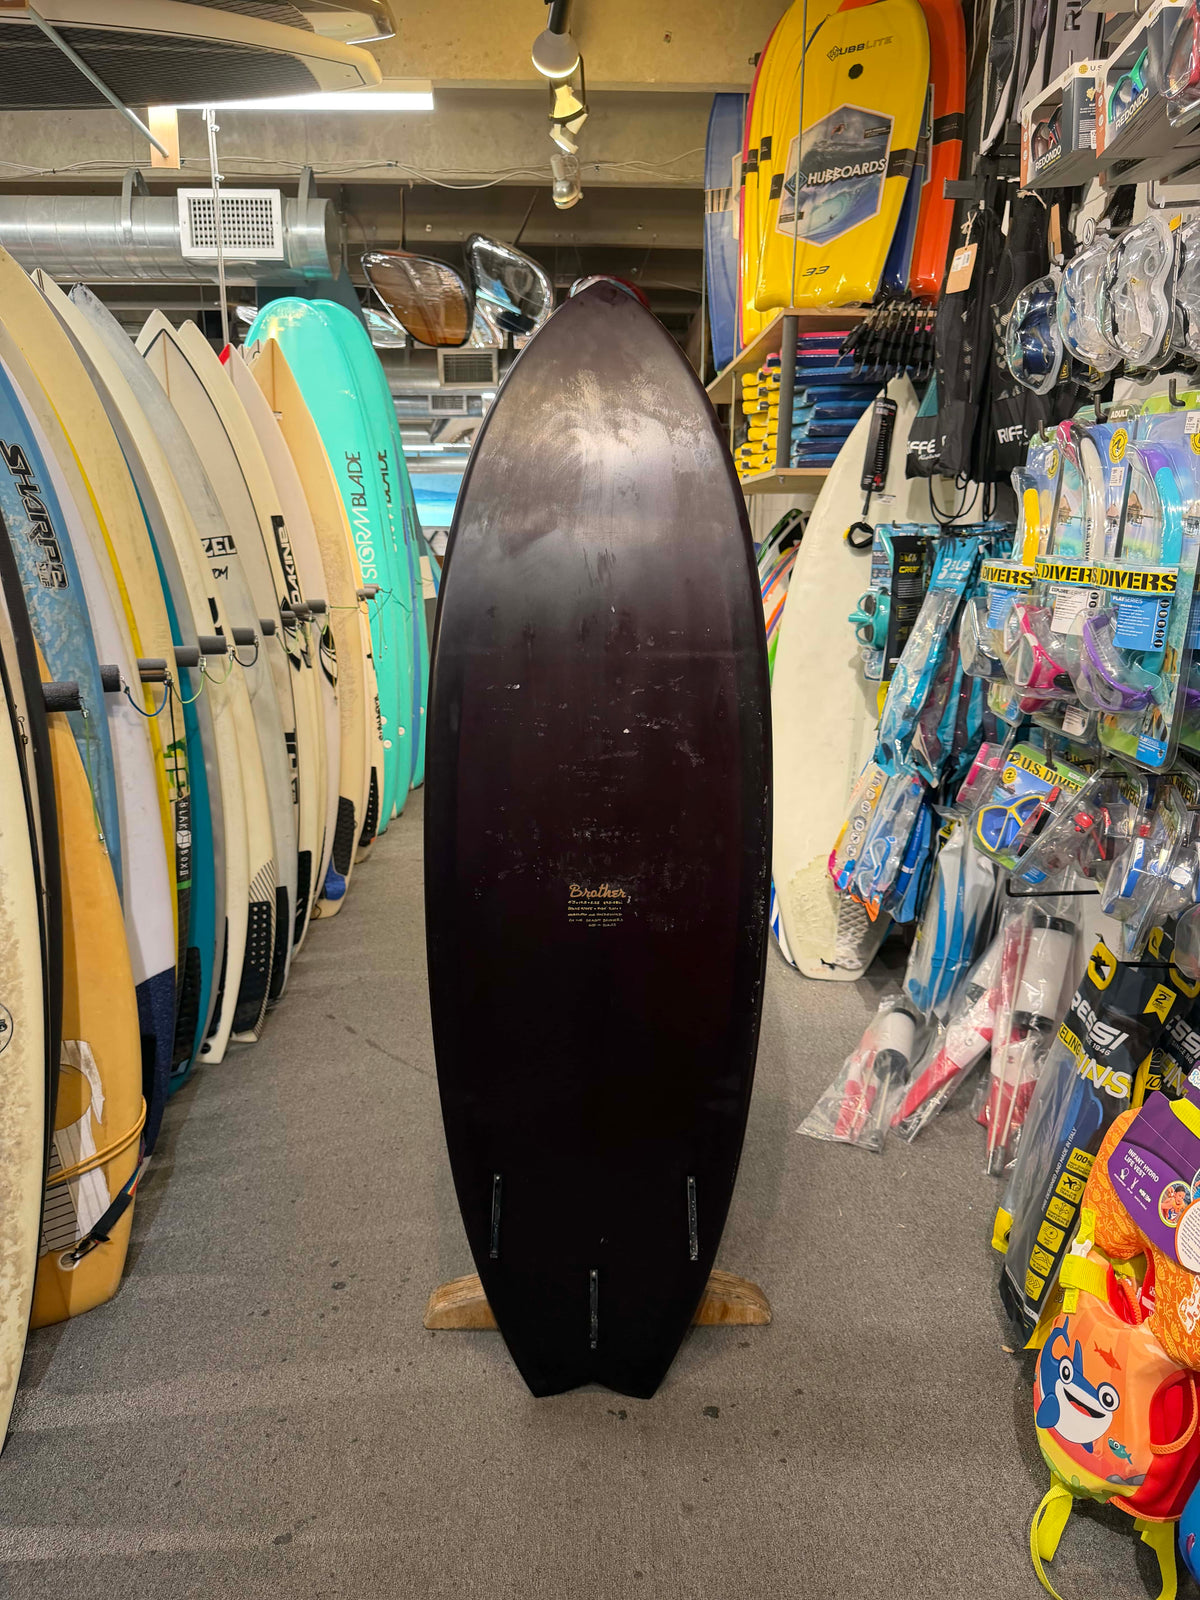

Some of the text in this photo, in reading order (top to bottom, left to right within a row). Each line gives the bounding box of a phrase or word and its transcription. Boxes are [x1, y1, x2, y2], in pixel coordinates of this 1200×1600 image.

[1115, 88, 1150, 131] REDONDO
[1035, 145, 1062, 172] REDONDO
[807, 157, 888, 186] HUBBOARDS
[802, 265, 831, 277] 33
[1110, 408, 1130, 419] ADULT
[1042, 564, 1093, 584] DIVER
[1099, 568, 1177, 592] DIVERS
[1021, 757, 1042, 778] U.S.
[569, 883, 627, 898] Brother
[1155, 993, 1168, 1005] 2
[1071, 990, 1130, 1050] RESSI
[1092, 1043, 1112, 1057] 1946
[1060, 1147, 1069, 1164] MADE
[1068, 1127, 1078, 1142] ITALY
[1124, 1154, 1147, 1179] LIFE VEST
[1128, 1148, 1145, 1167] INFANT
[1142, 1163, 1160, 1183] HYDRO
